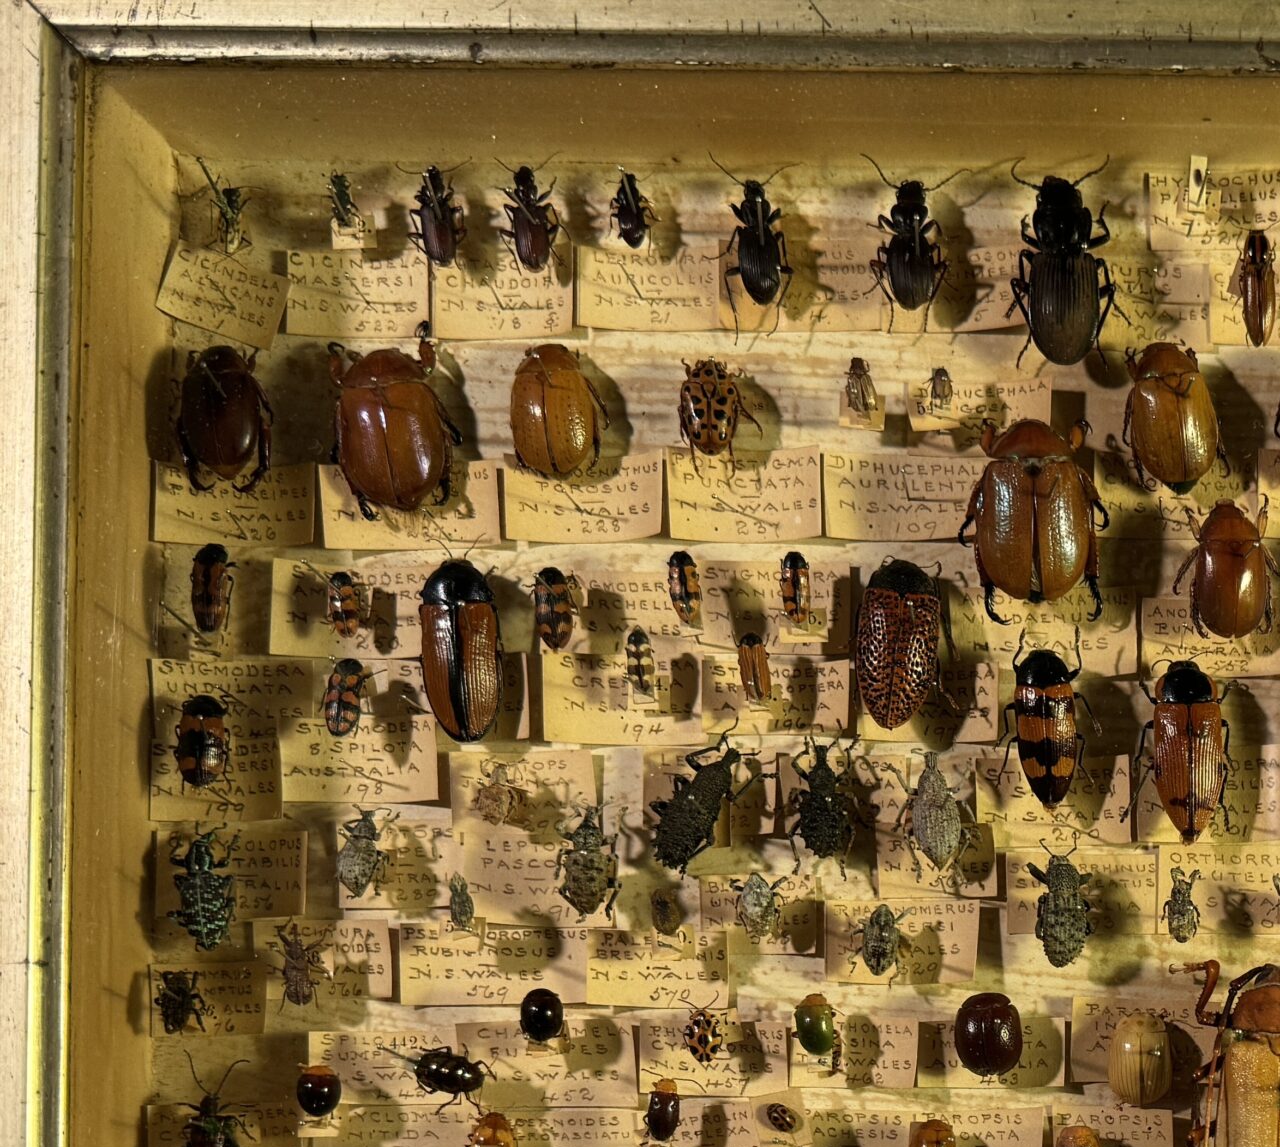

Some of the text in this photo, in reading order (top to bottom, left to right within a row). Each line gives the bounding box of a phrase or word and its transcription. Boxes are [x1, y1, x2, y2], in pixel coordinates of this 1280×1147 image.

[291, 275, 414, 288] MASTERSI
[592, 273, 715, 284] AURICOLLIS
[671, 454, 818, 470] POLYSTIGMA
[682, 474, 804, 489] PUNCTATA
[159, 661, 304, 676] STIGMODERA
[166, 681, 291, 694] UNDULATA
[805, 1112, 903, 1125] PAROPSIS
[926, 1113, 1022, 1126] PAROPSIS
[1057, 1113, 1163, 1126] PAROPSIS
[349, 1130, 439, 1140] NITIDA
[813, 1127, 897, 1140] ACHESIS
[959, 1130, 1019, 1141] OVATA
